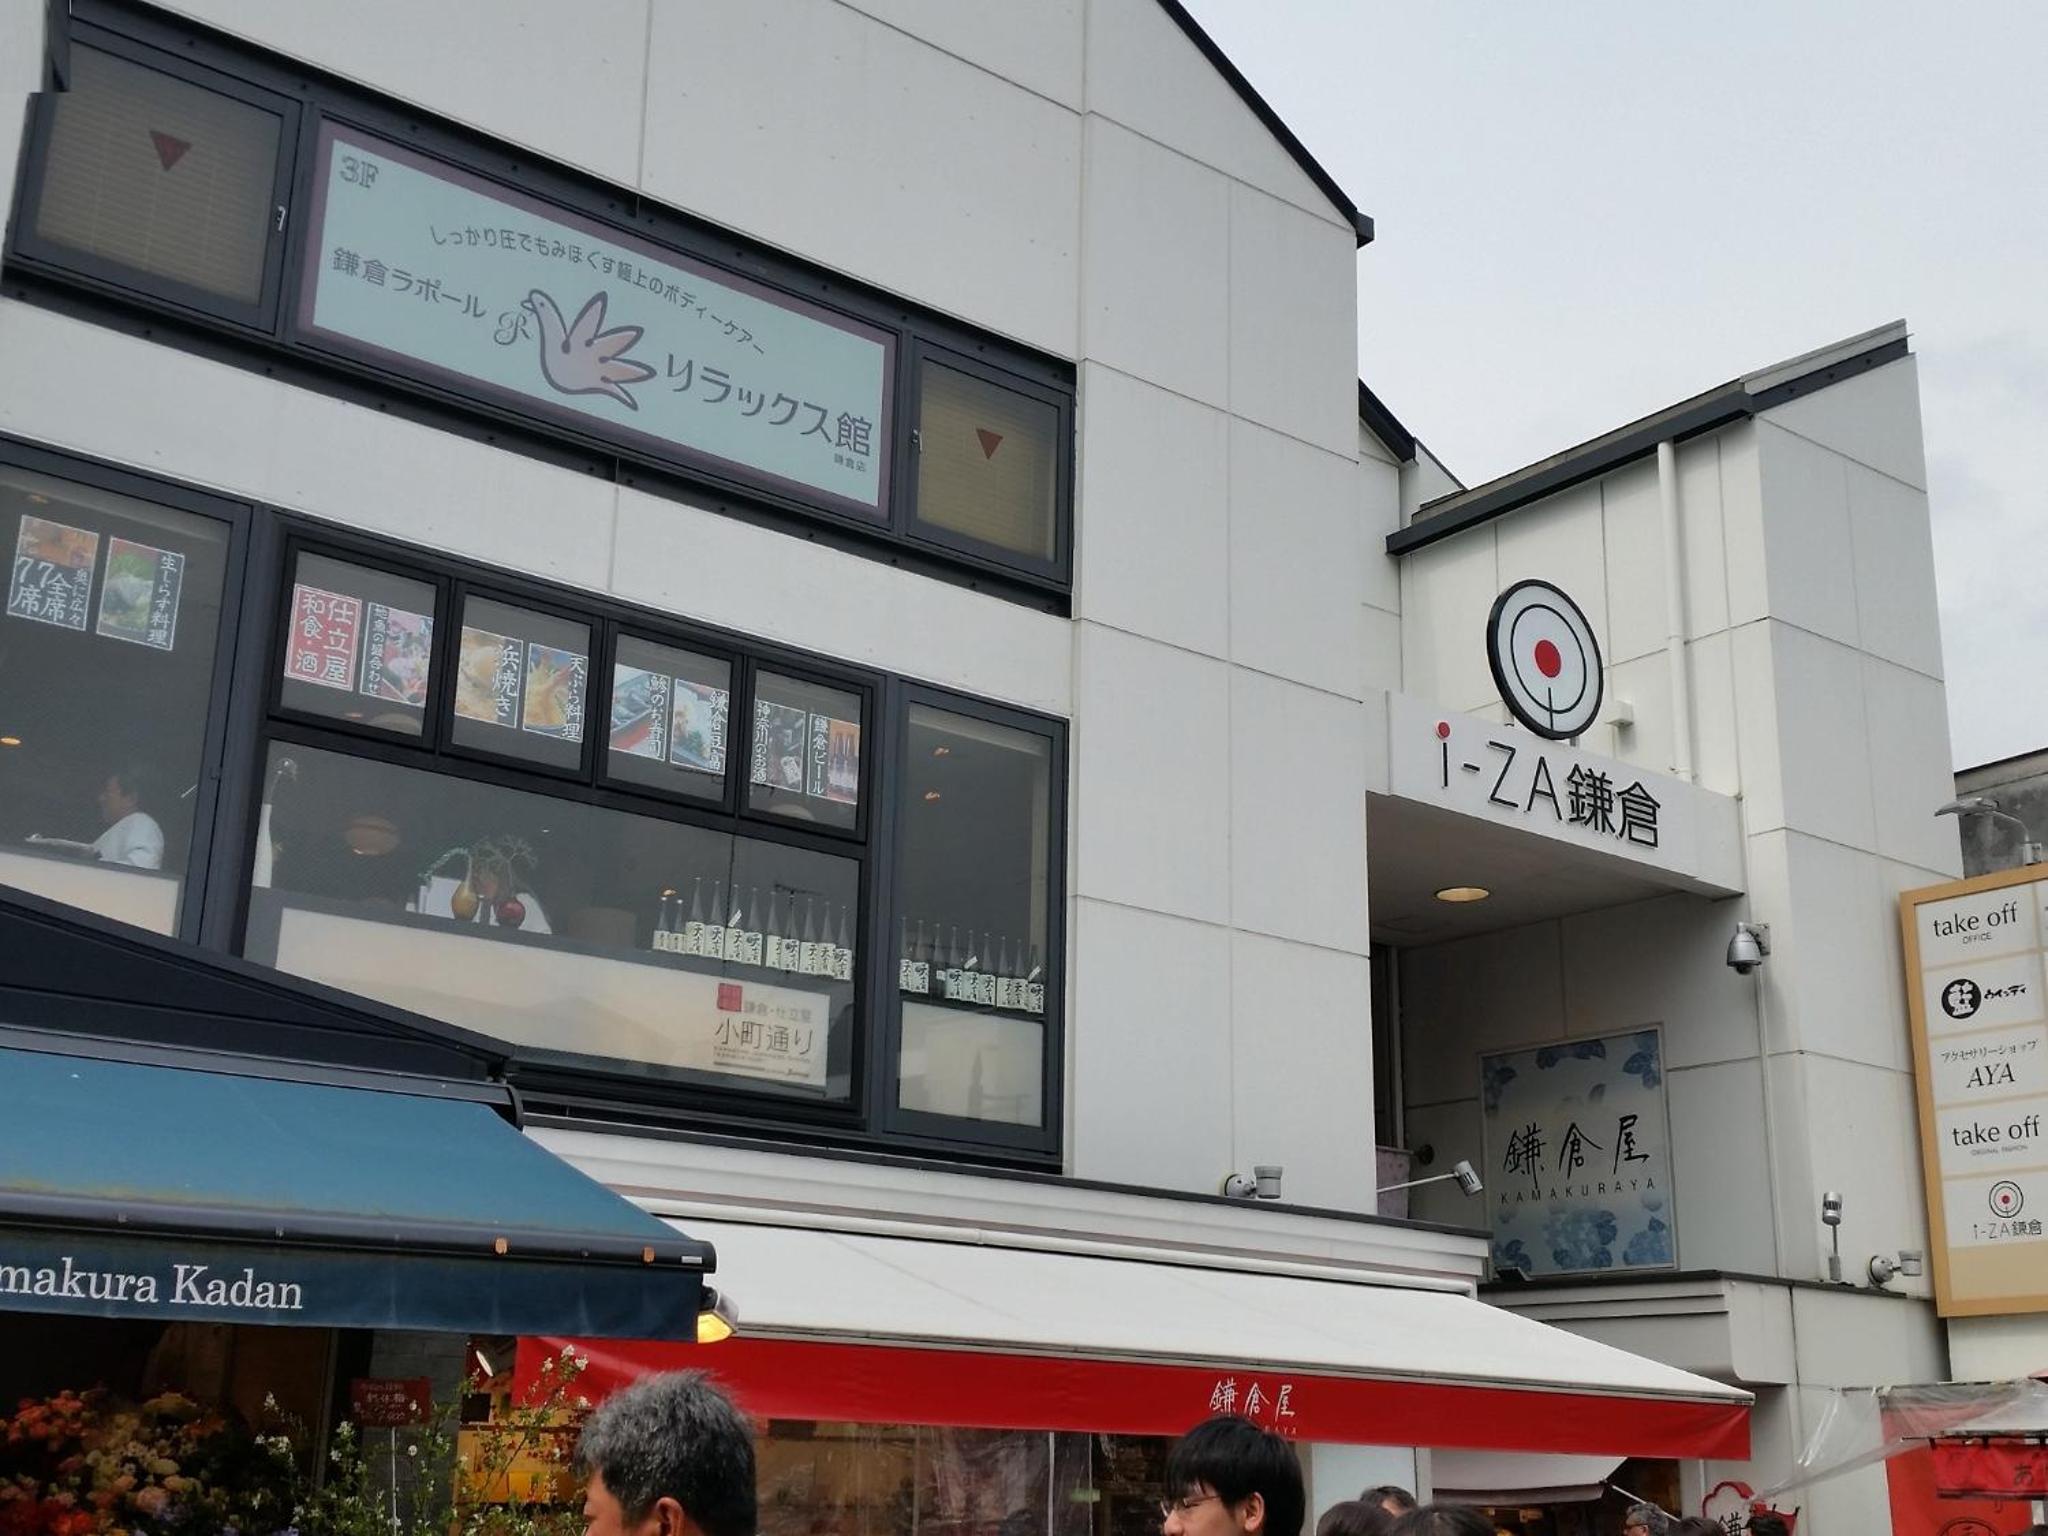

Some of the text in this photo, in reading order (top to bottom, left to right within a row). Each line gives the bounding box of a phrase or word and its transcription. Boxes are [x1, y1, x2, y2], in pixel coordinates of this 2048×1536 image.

[339, 156, 379, 189] 3F
[332, 246, 487, 319] 鎌倉ラポール
[667, 353, 873, 457] リラックス館
[147, 555, 177, 646] 生しらす料理
[320, 600, 353, 684] 仕立屋
[492, 644, 520, 717] 浜焼き
[562, 657, 585, 739] 天ぷら料理
[1933, 901, 2017, 937] take off
[715, 1018, 813, 1055] 小町通り
[1966, 1062, 2016, 1089] AYA
[1503, 1114, 1650, 1189] 鎌倉屋
[1952, 1114, 2040, 1146] take off
[1501, 1177, 1656, 1205] KAMAKURAYA
[169, 1264, 303, 1310] Kadan
[1209, 1376, 1295, 1422] 鎌倉屋
